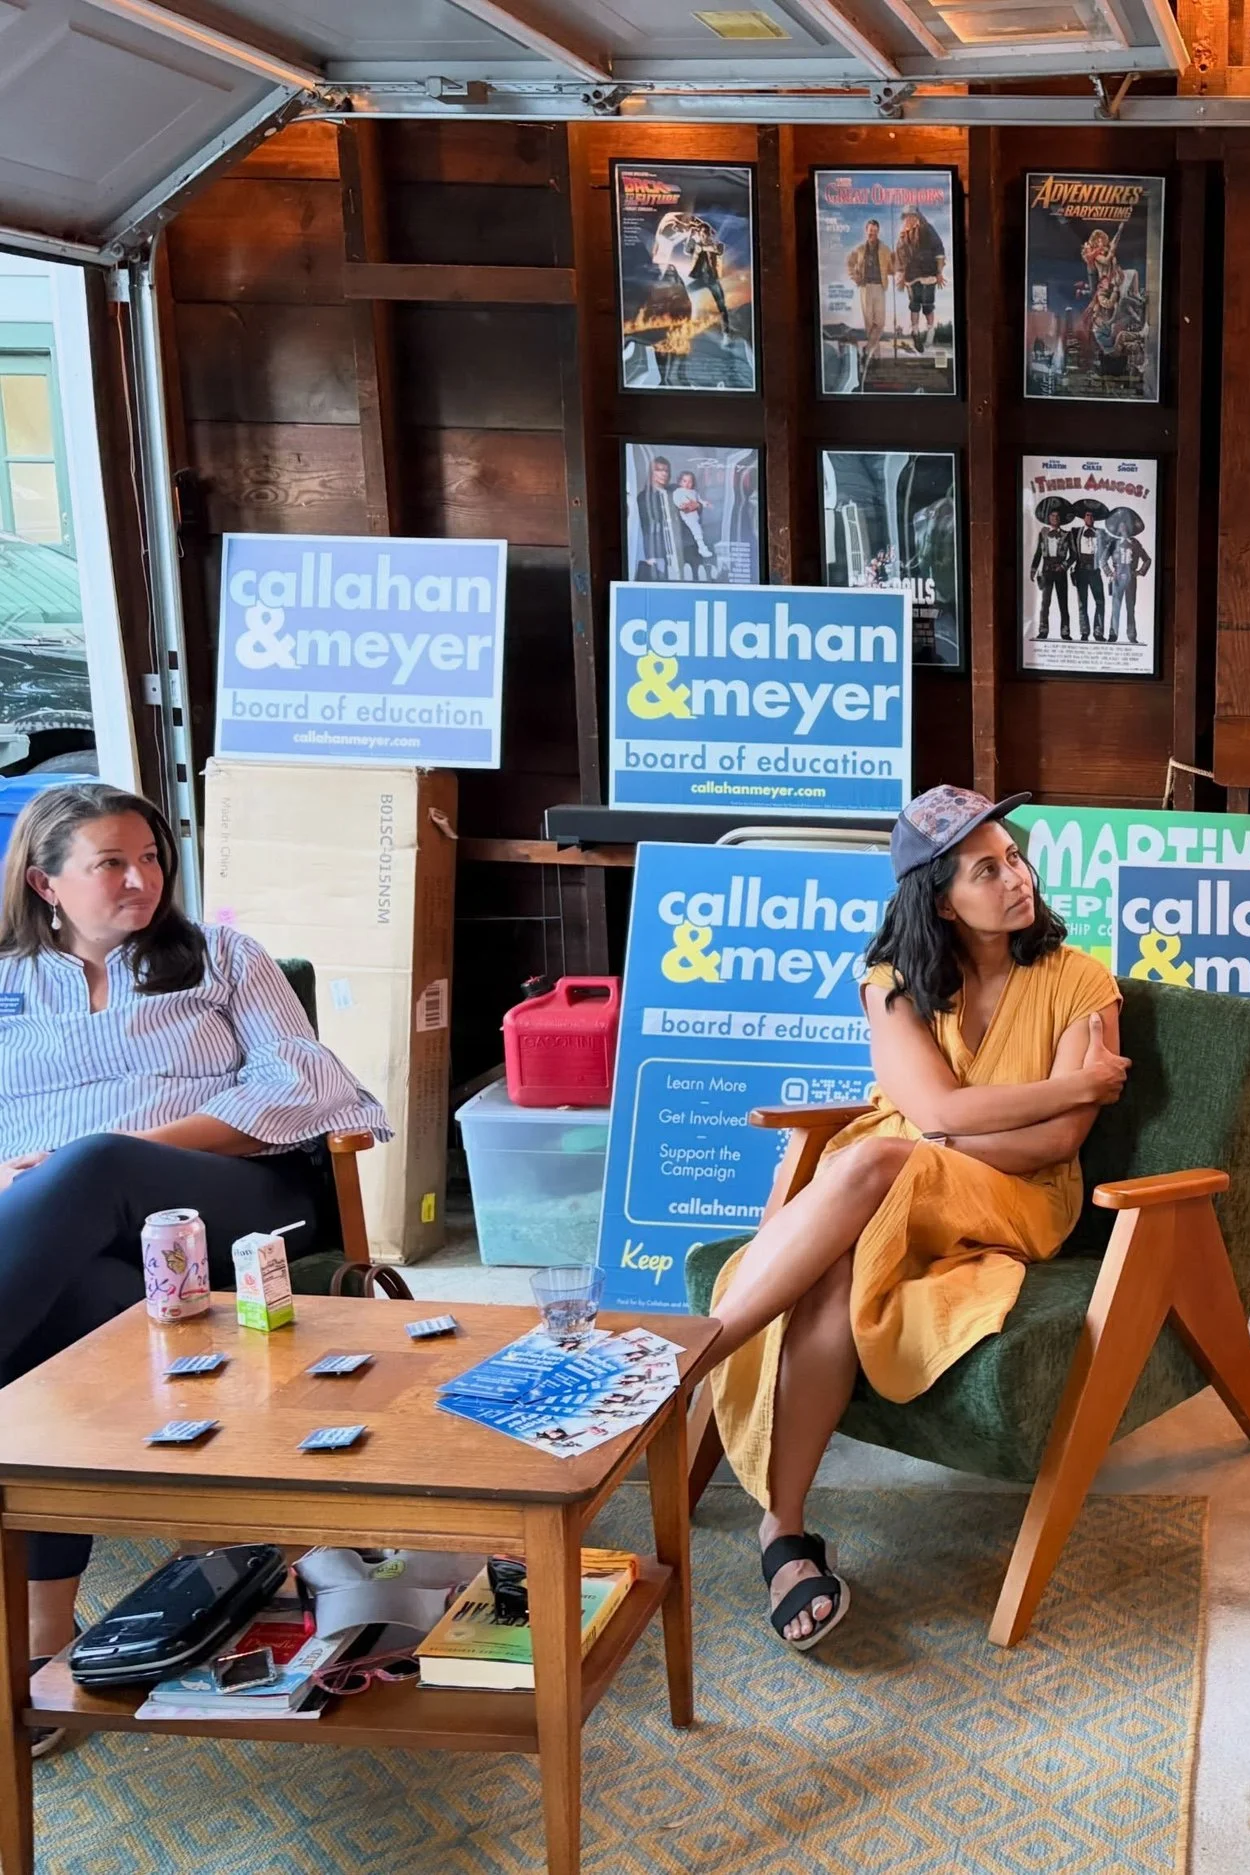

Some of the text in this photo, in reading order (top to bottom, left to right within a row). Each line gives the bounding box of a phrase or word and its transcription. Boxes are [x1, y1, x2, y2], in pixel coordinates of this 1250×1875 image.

[1031, 175, 1143, 208] ADVENTURES
[1064, 205, 1133, 218] BABYSITTING
[230, 552, 491, 613] callahan
[619, 600, 897, 663] callahan
[231, 691, 483, 726] board of education
[293, 730, 421, 749] callahanmeyer.com
[625, 742, 893, 776] board of education
[691, 781, 826, 799] callahanmeyer.com
[658, 876, 889, 933] callaha
[662, 1011, 732, 1036] board
[742, 1014, 766, 1037] of
[667, 1075, 747, 1093] Learn More
[659, 1109, 747, 1127] Get Involved
[659, 1144, 741, 1162] Support the
[661, 1162, 736, 1182] Campaign
[621, 1239, 673, 1285] Keep
